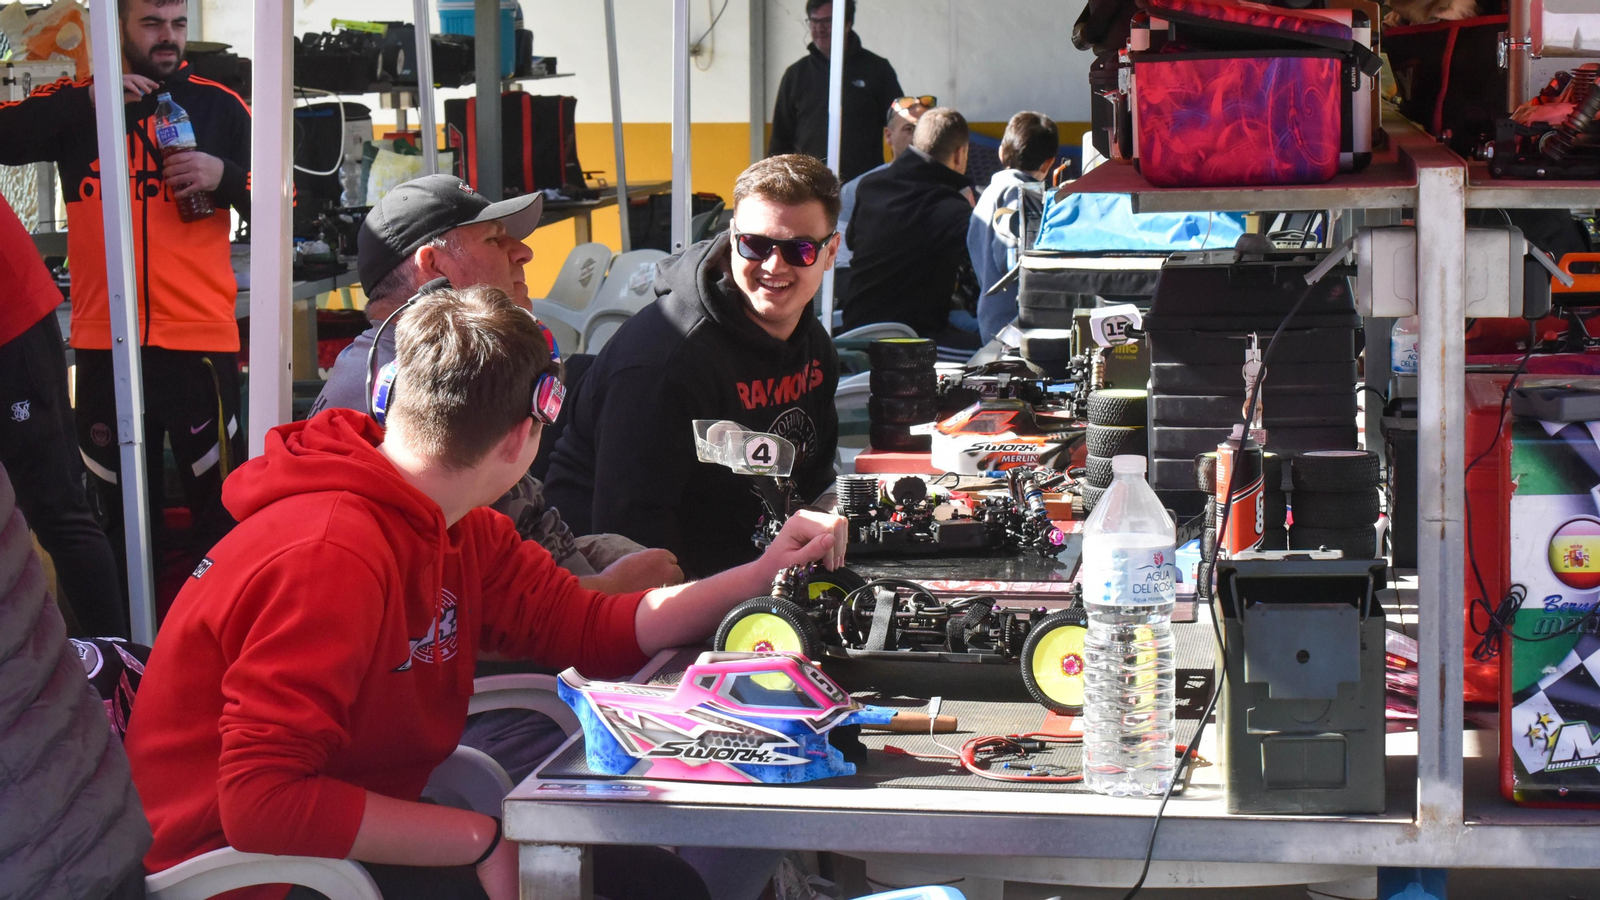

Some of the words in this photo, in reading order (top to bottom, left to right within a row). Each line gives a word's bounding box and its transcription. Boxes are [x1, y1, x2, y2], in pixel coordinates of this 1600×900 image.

[752, 443, 771, 464] 4
[1001, 454, 1039, 463] MERLIN
[1145, 570, 1170, 581] AGUA
[1132, 583, 1152, 594] DEL
[1153, 581, 1175, 593] ROSA
